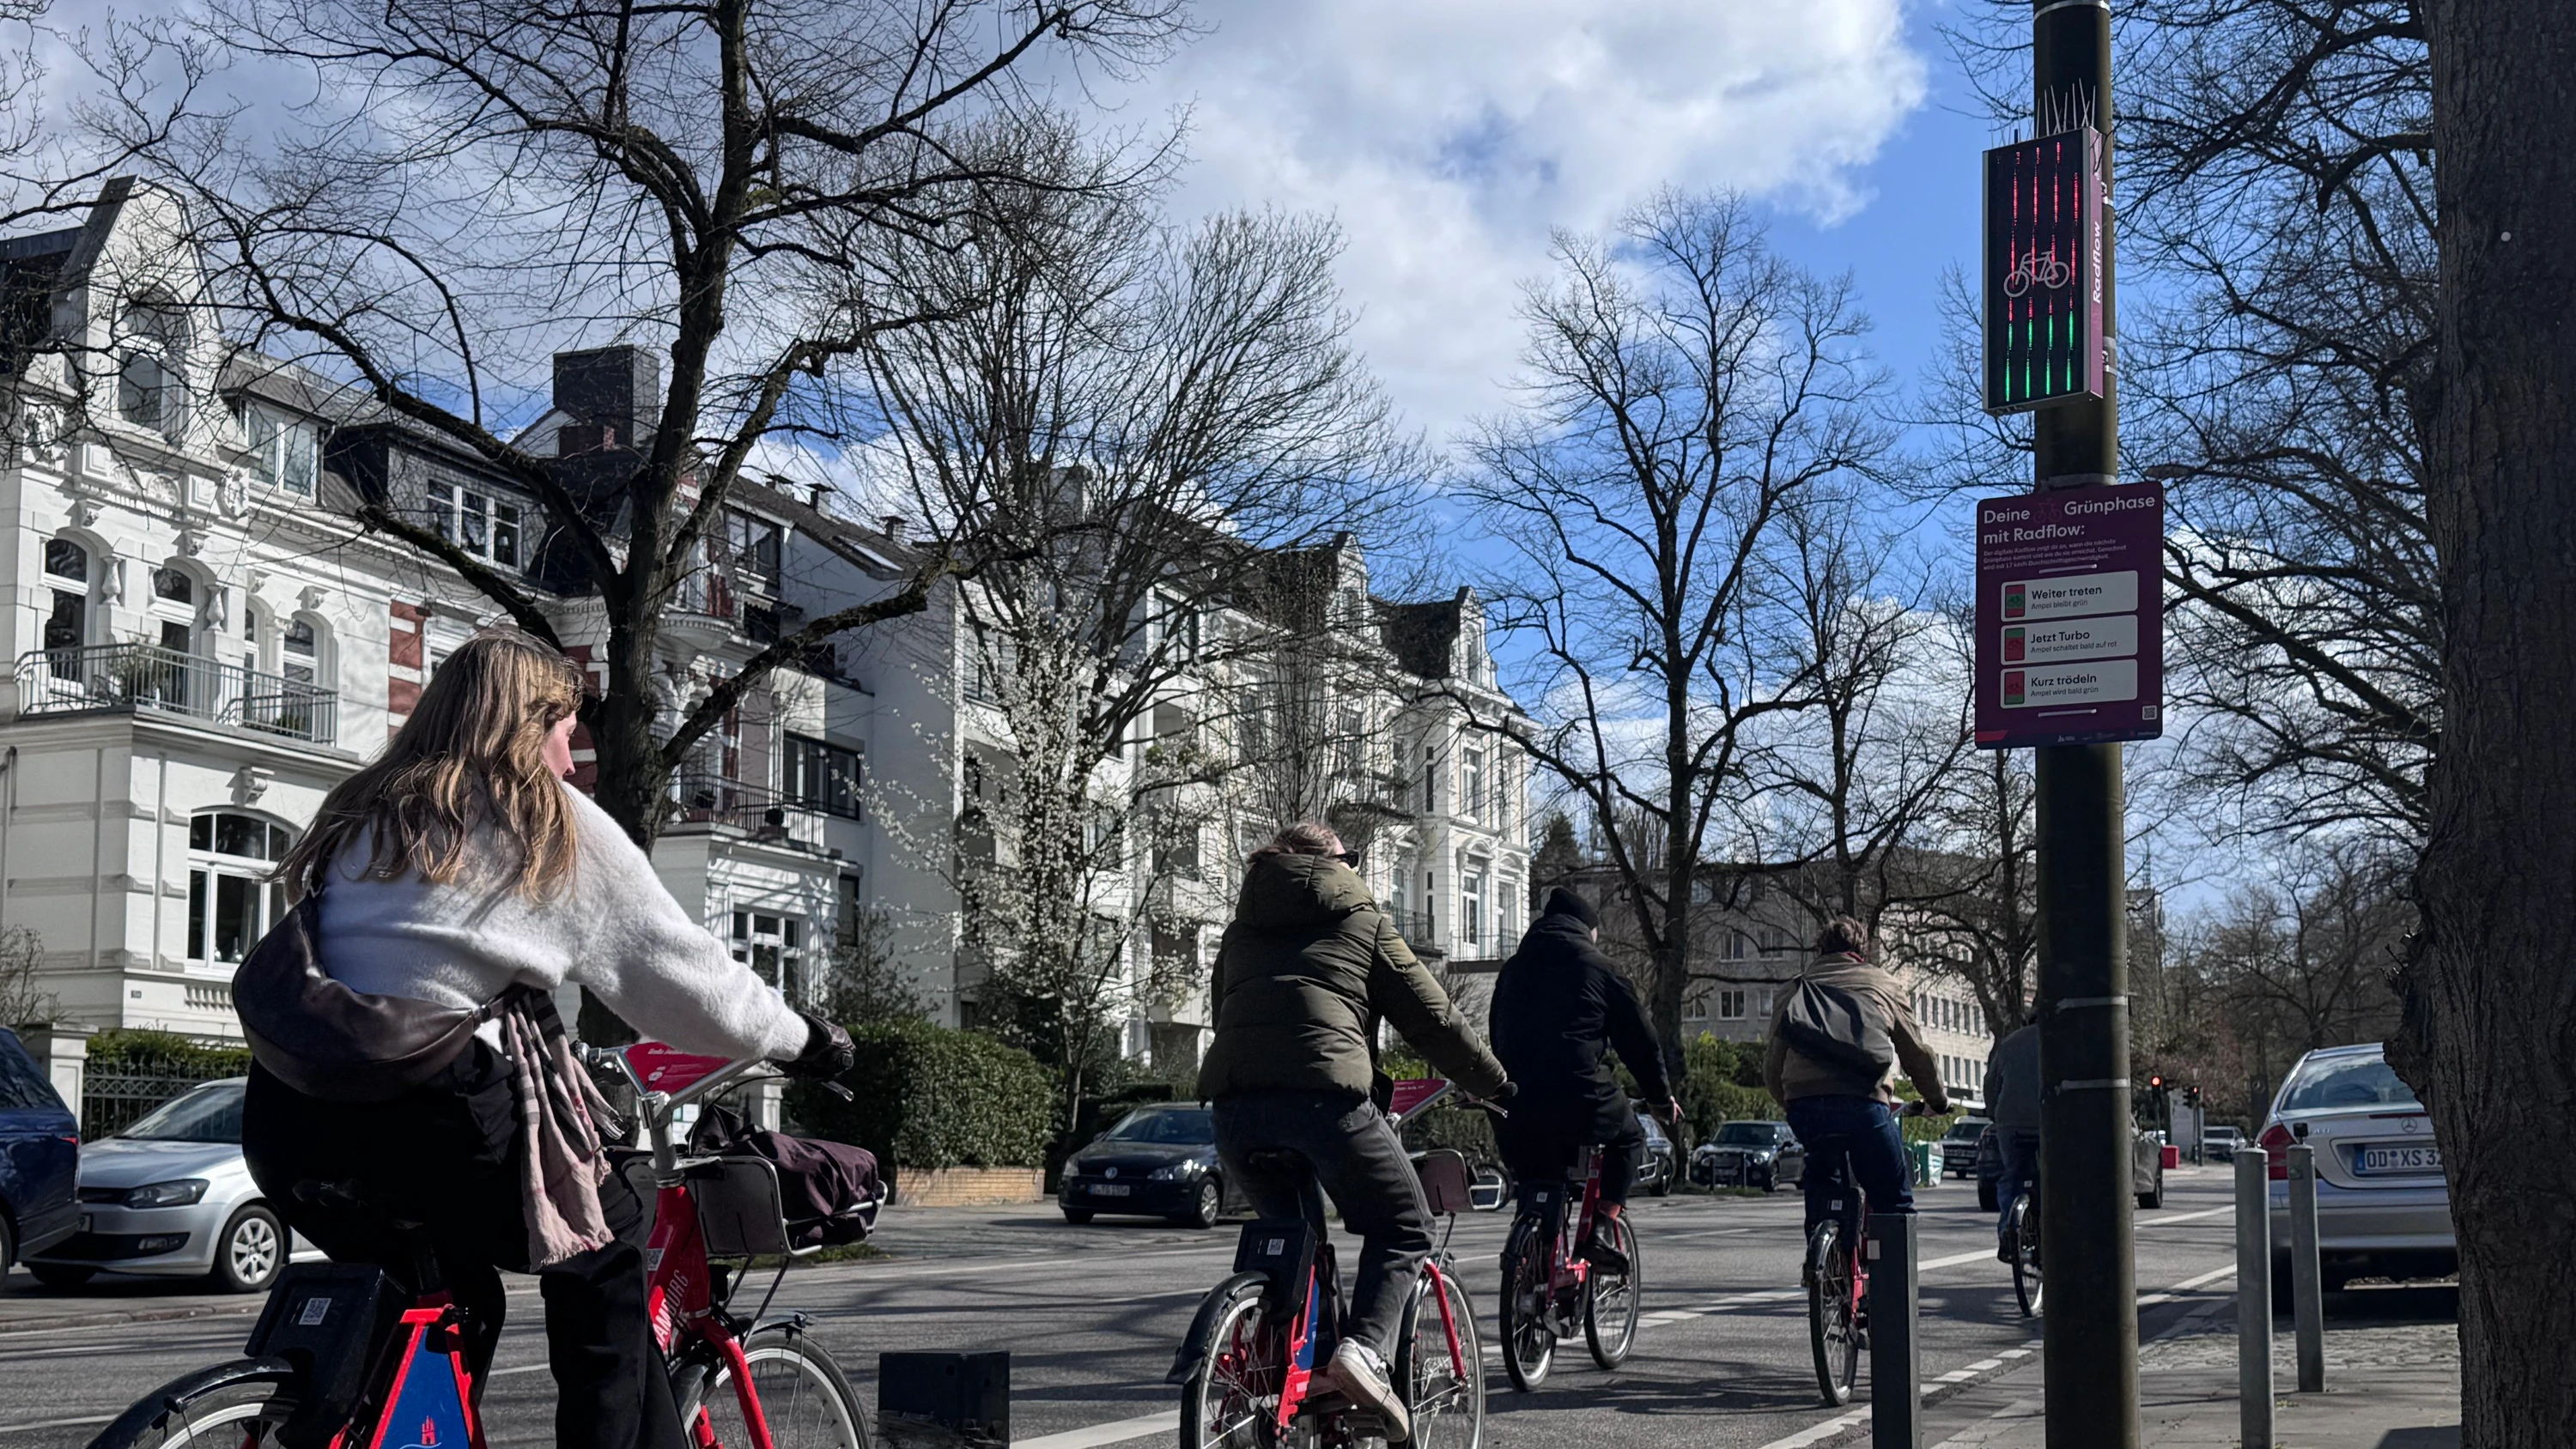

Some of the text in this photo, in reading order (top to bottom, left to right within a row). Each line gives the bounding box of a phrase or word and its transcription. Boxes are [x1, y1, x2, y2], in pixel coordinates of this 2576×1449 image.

[2093, 221, 2101, 304] Radflow
[1984, 496, 2155, 524] Deine Grünphase
[1984, 524, 2085, 544] mit Radflow:
[2032, 586, 2102, 599] Weiter treten
[2073, 599, 2088, 608] grün
[2031, 631, 2090, 644] Jetzt Turbo
[2031, 674, 2097, 688] Kurz trödeln
[2083, 686, 2099, 694] grün
[2366, 1151, 2387, 1167] OD
[2401, 1150, 2421, 1167] XS
